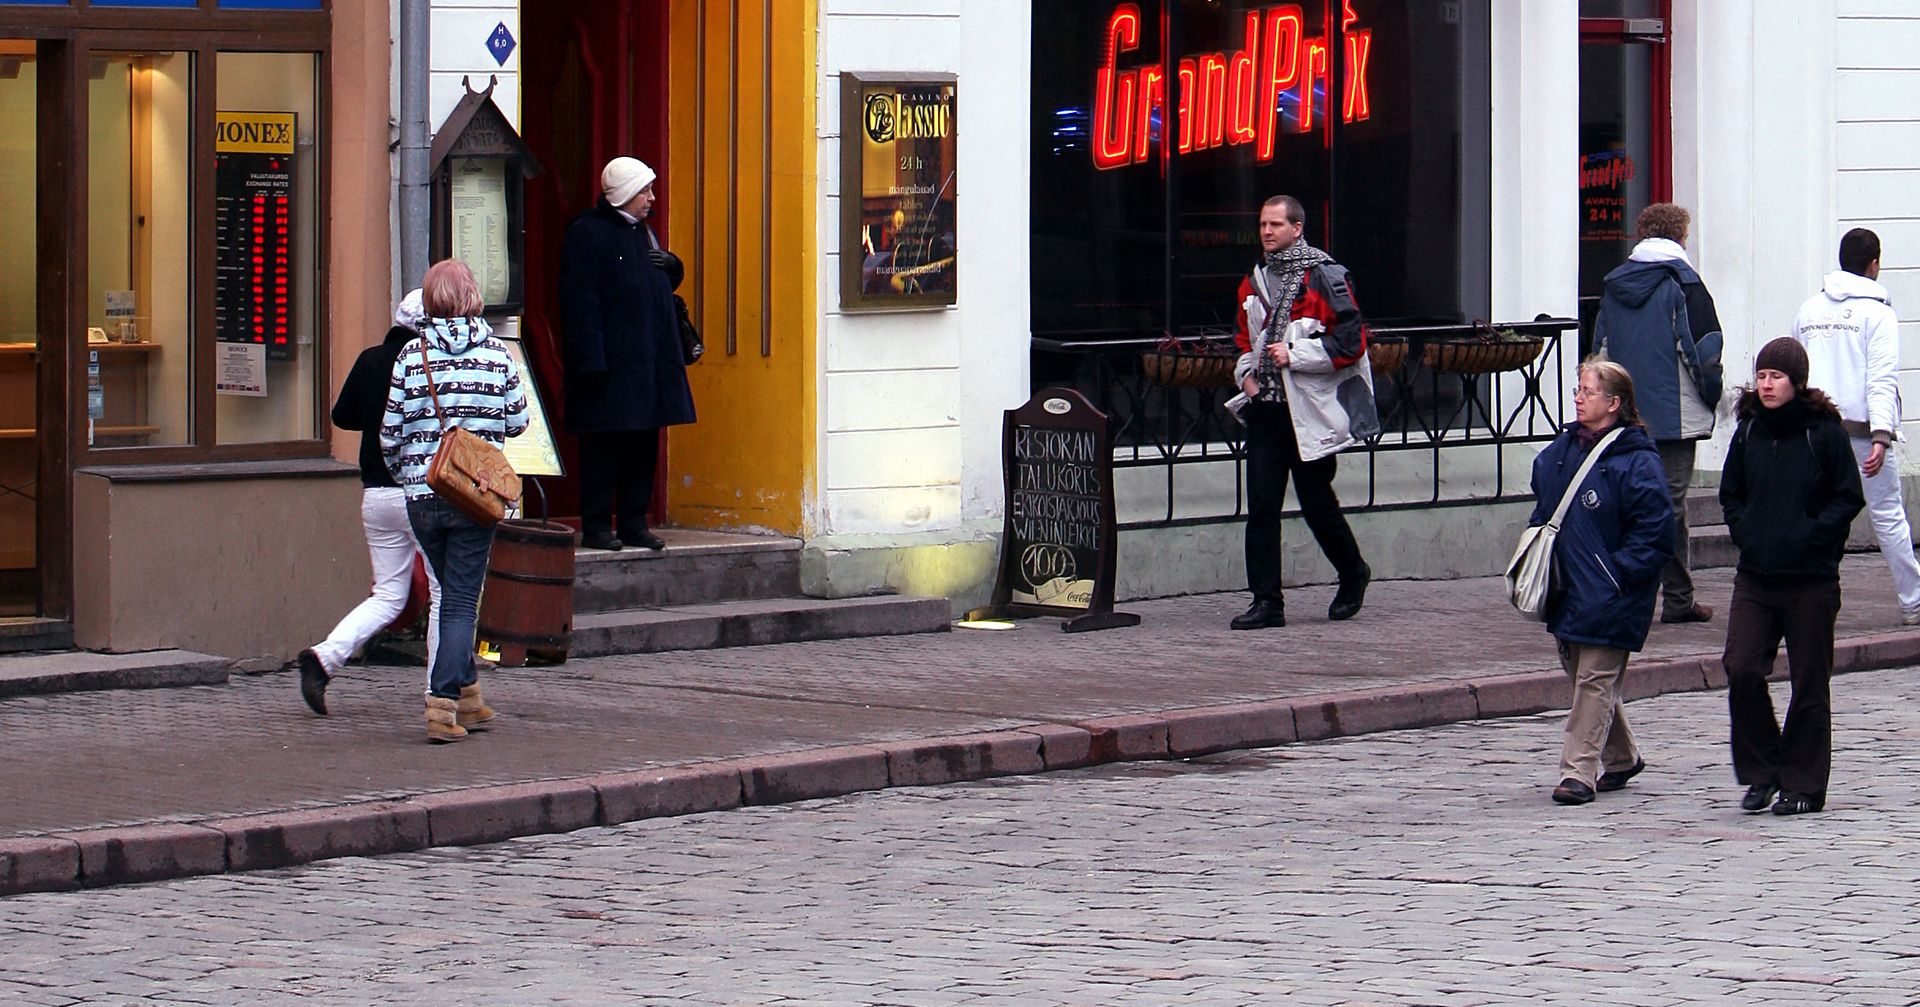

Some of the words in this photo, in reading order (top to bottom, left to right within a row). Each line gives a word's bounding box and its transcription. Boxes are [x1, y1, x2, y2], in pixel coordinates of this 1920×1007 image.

[497, 26, 504, 35] H
[902, 93, 950, 101] CASINO
[865, 93, 950, 143] Classic
[900, 155, 912, 170] 24
[916, 155, 923, 170] h
[1590, 208, 1608, 221] 24
[1015, 429, 1096, 462] RESTORAN
